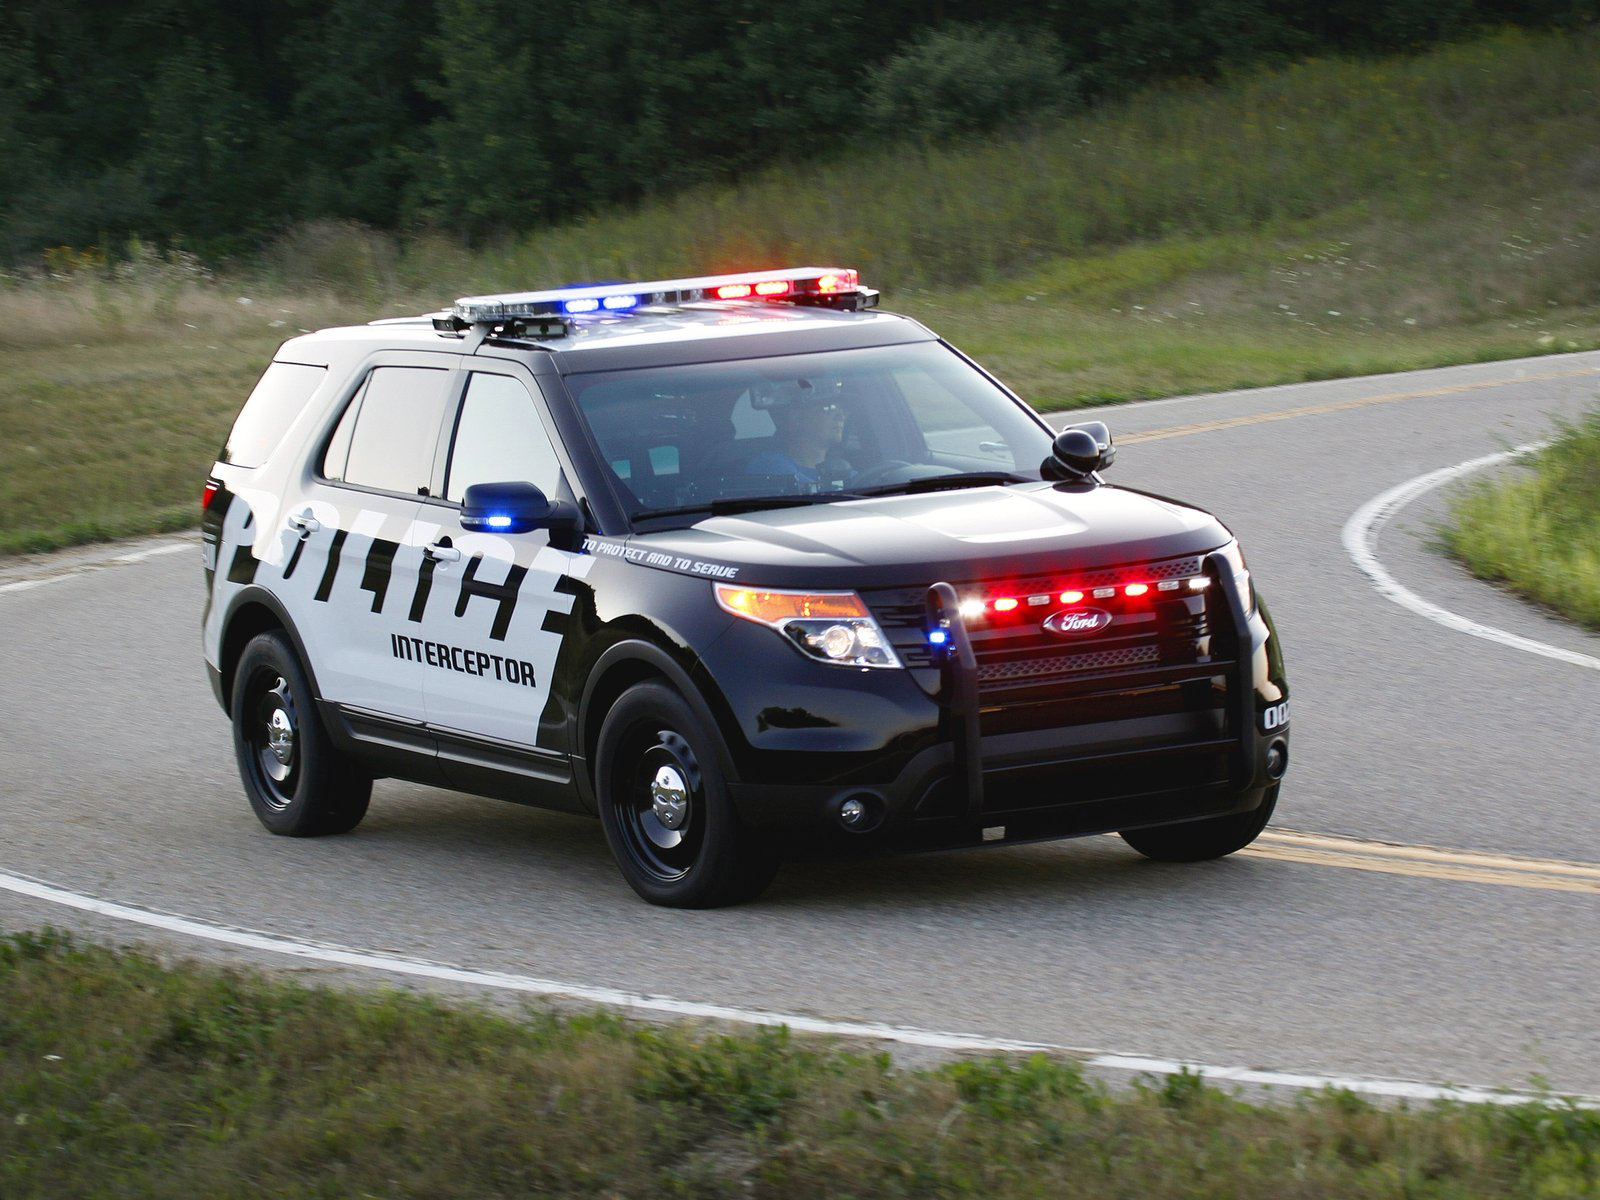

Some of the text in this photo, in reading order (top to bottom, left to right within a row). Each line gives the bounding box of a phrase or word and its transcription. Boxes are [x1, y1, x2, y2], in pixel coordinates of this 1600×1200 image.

[220, 491, 598, 642] POLICE
[582, 538, 739, 578] TO PROTECT AND TO SERVE
[1061, 612, 1099, 631] Ford
[391, 633, 536, 688] INTERCEPTOR
